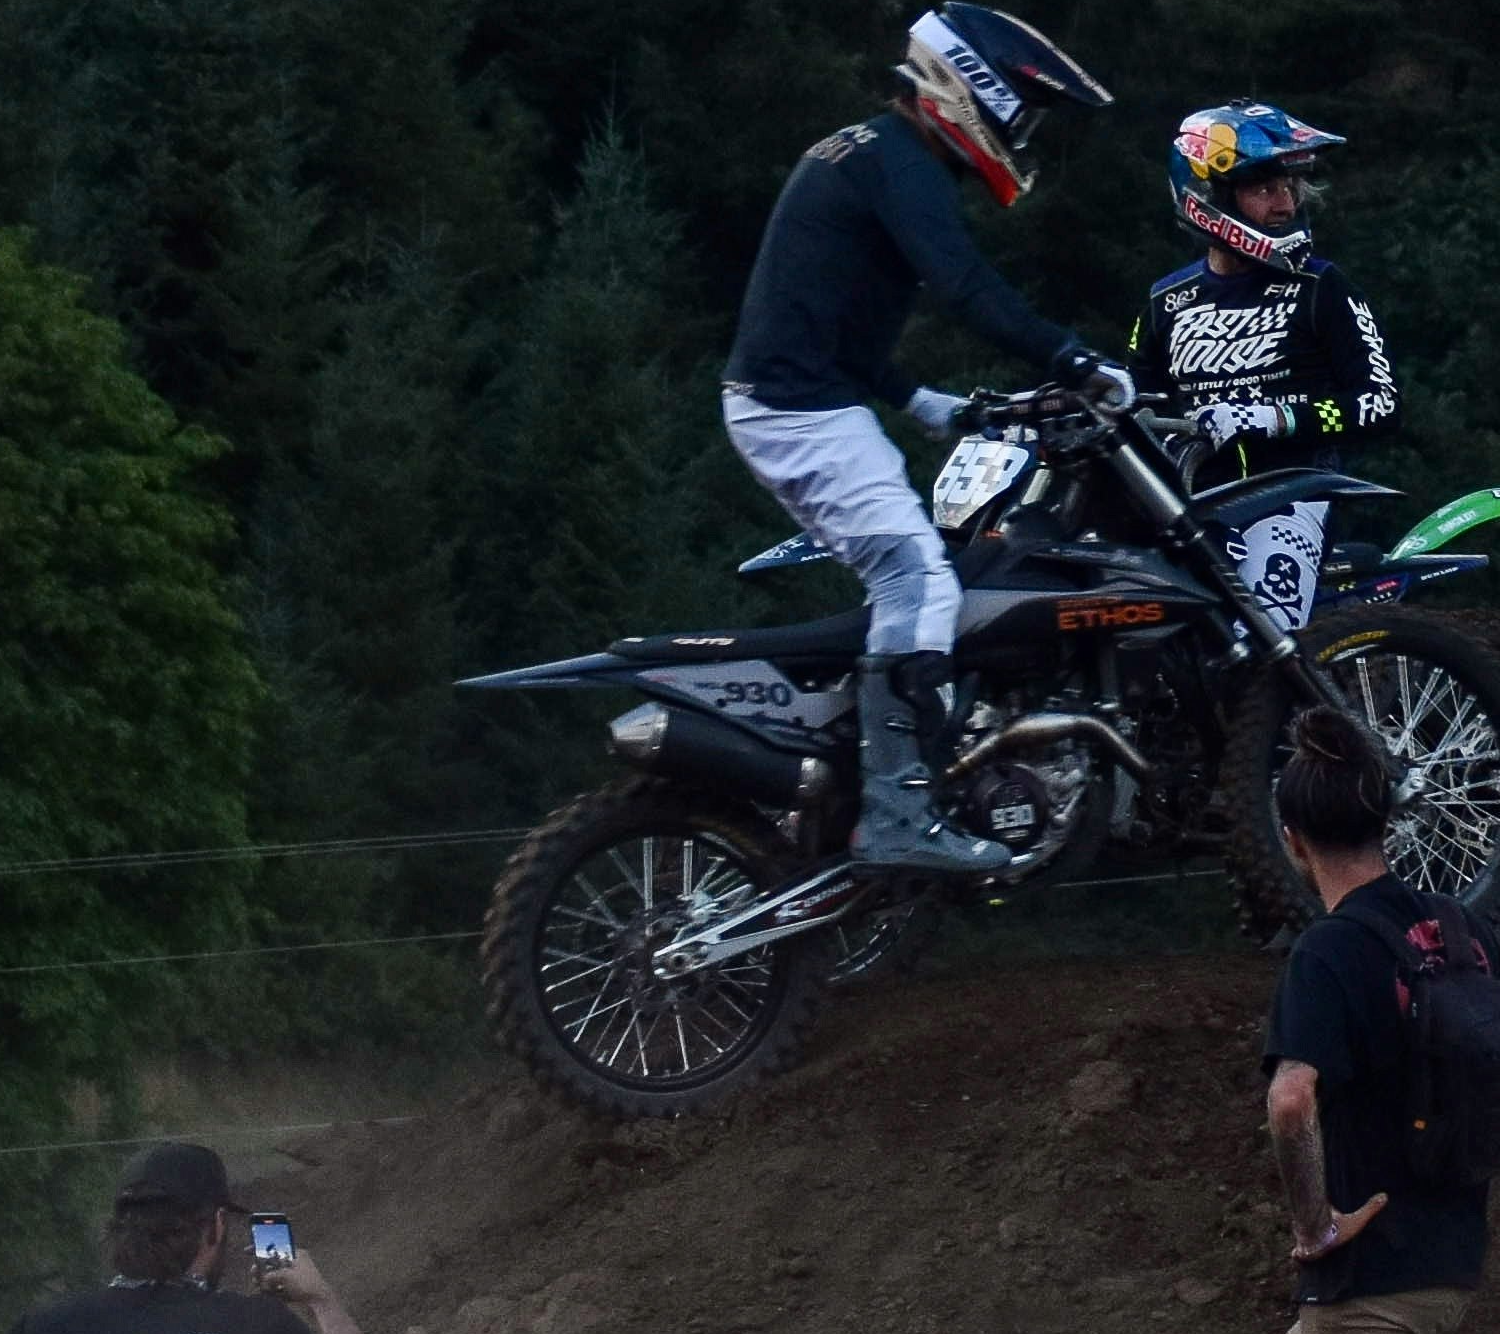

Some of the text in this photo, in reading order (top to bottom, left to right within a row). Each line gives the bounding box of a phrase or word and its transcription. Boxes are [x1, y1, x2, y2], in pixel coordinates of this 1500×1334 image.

[1184, 194, 1274, 261] Red Bull
[1058, 603, 1165, 630] ETHOS
